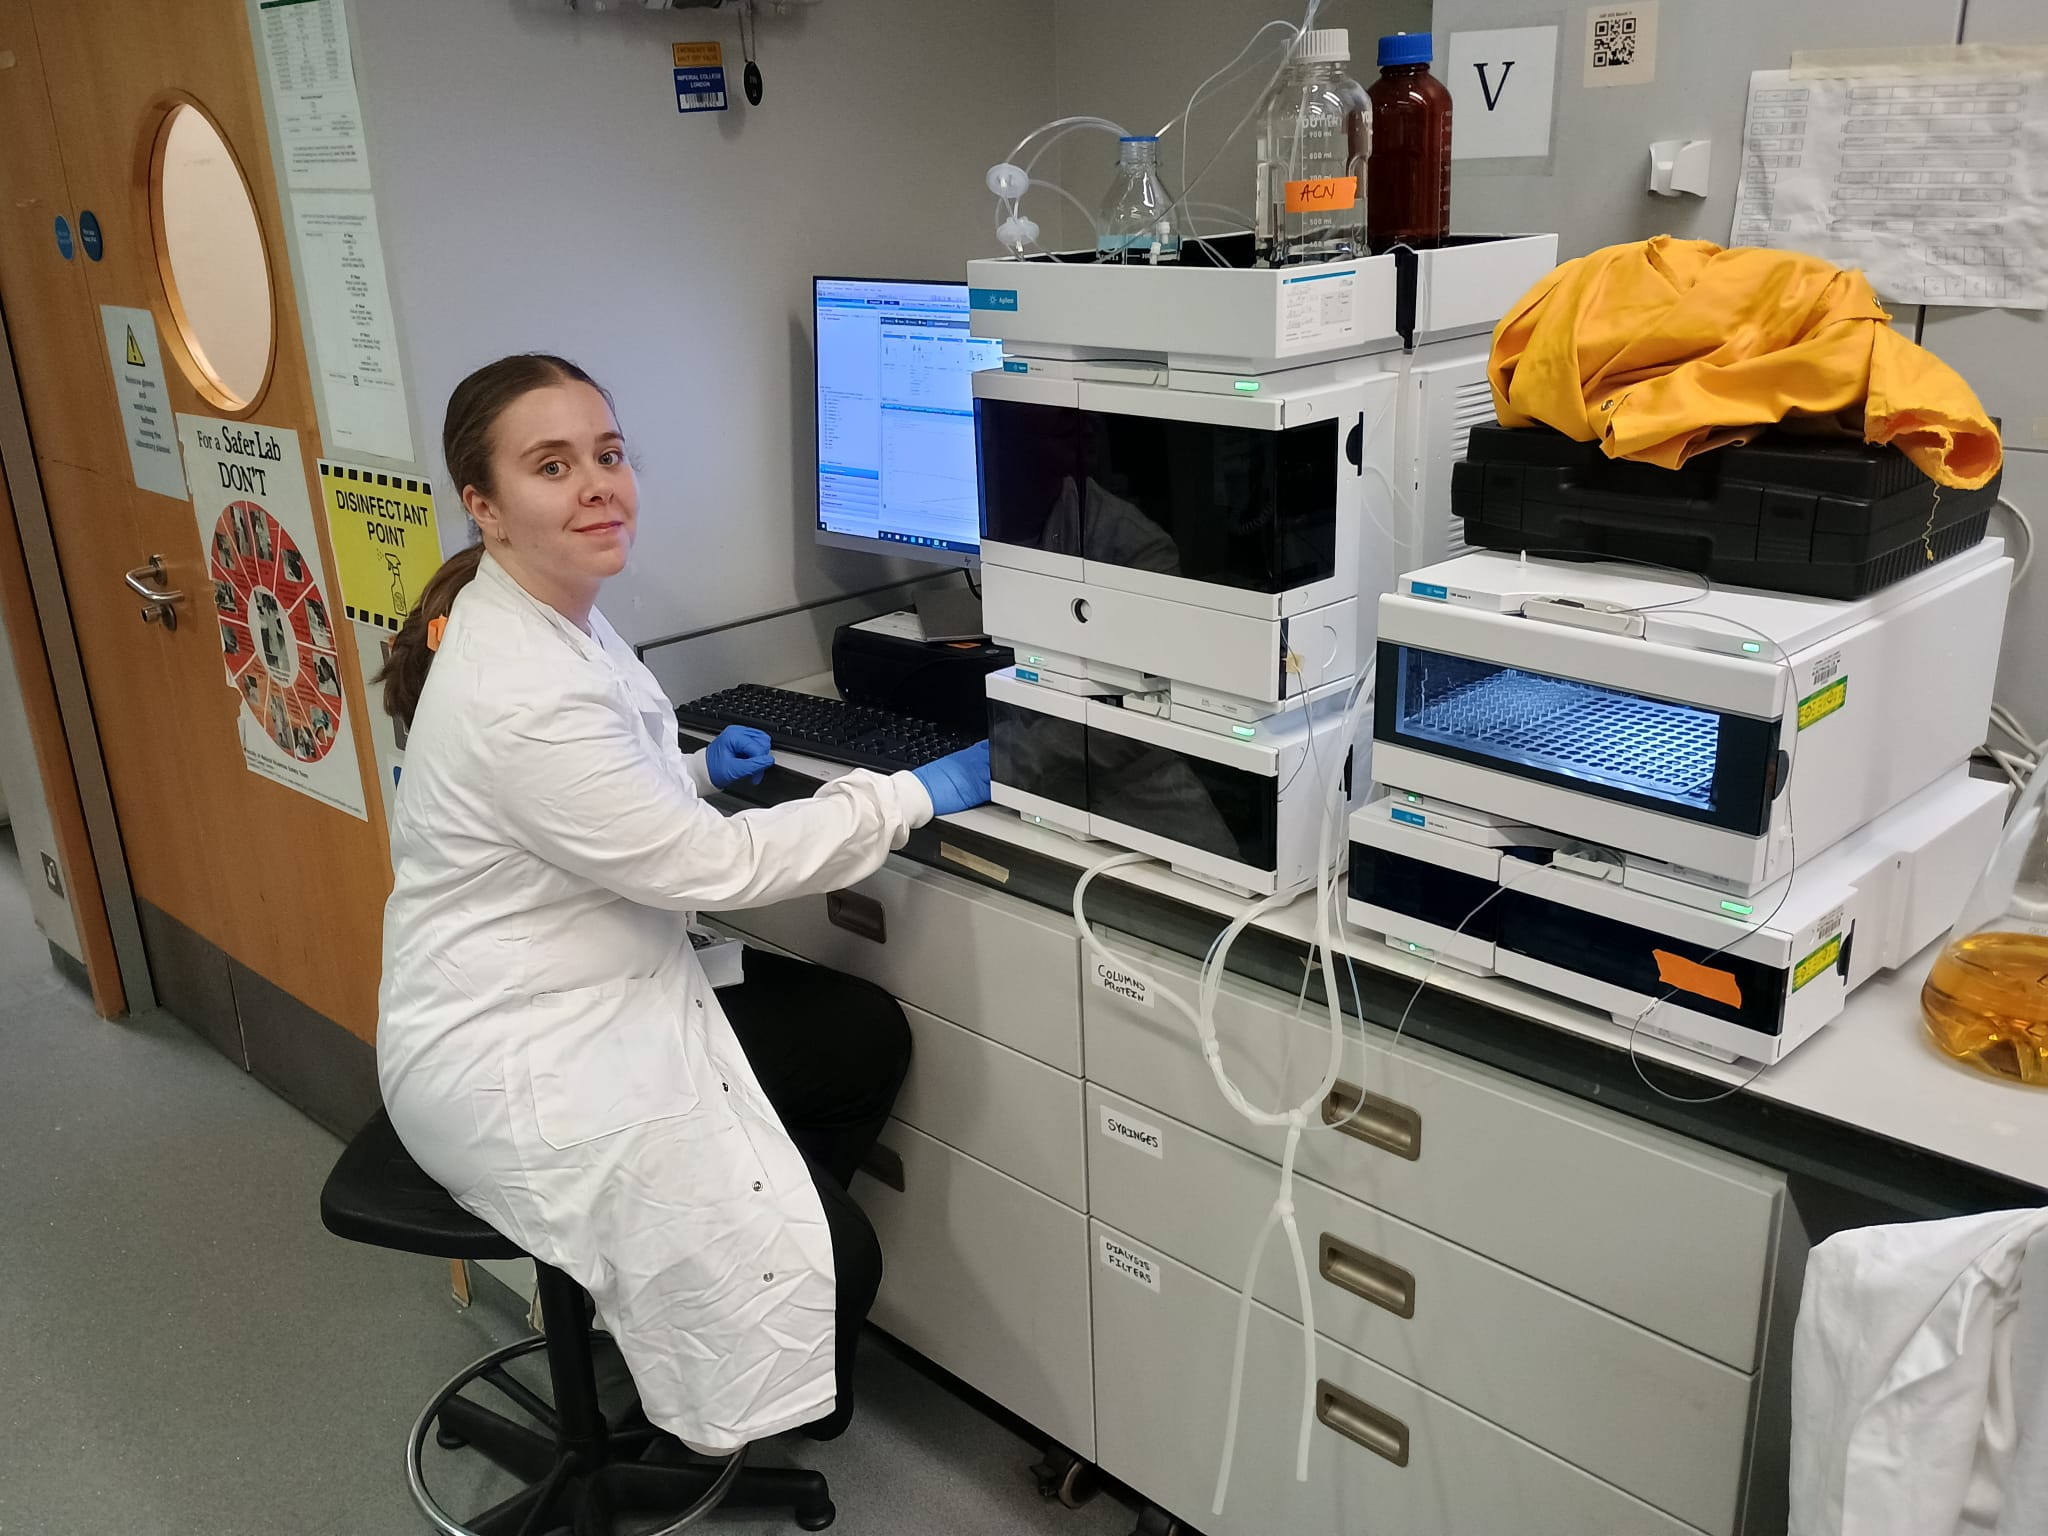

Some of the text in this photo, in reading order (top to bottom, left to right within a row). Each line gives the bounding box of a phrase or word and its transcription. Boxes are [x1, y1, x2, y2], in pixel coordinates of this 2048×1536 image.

[1473, 61, 1515, 111] V
[1299, 183, 1335, 202] ACN
[998, 296, 1015, 305] Agilent
[196, 425, 281, 461] For a Safer Lab
[217, 461, 266, 496] DON'T
[335, 489, 428, 527] DISINFECTANT
[366, 520, 405, 548] POINT
[1097, 964, 1146, 992] COLUMNS
[1104, 978, 1145, 1002] PROTEIN
[1107, 1118, 1159, 1149] SYRINGES
[1106, 1242, 1151, 1271] DIALYSIS
[1108, 1254, 1152, 1284] FILTERS
